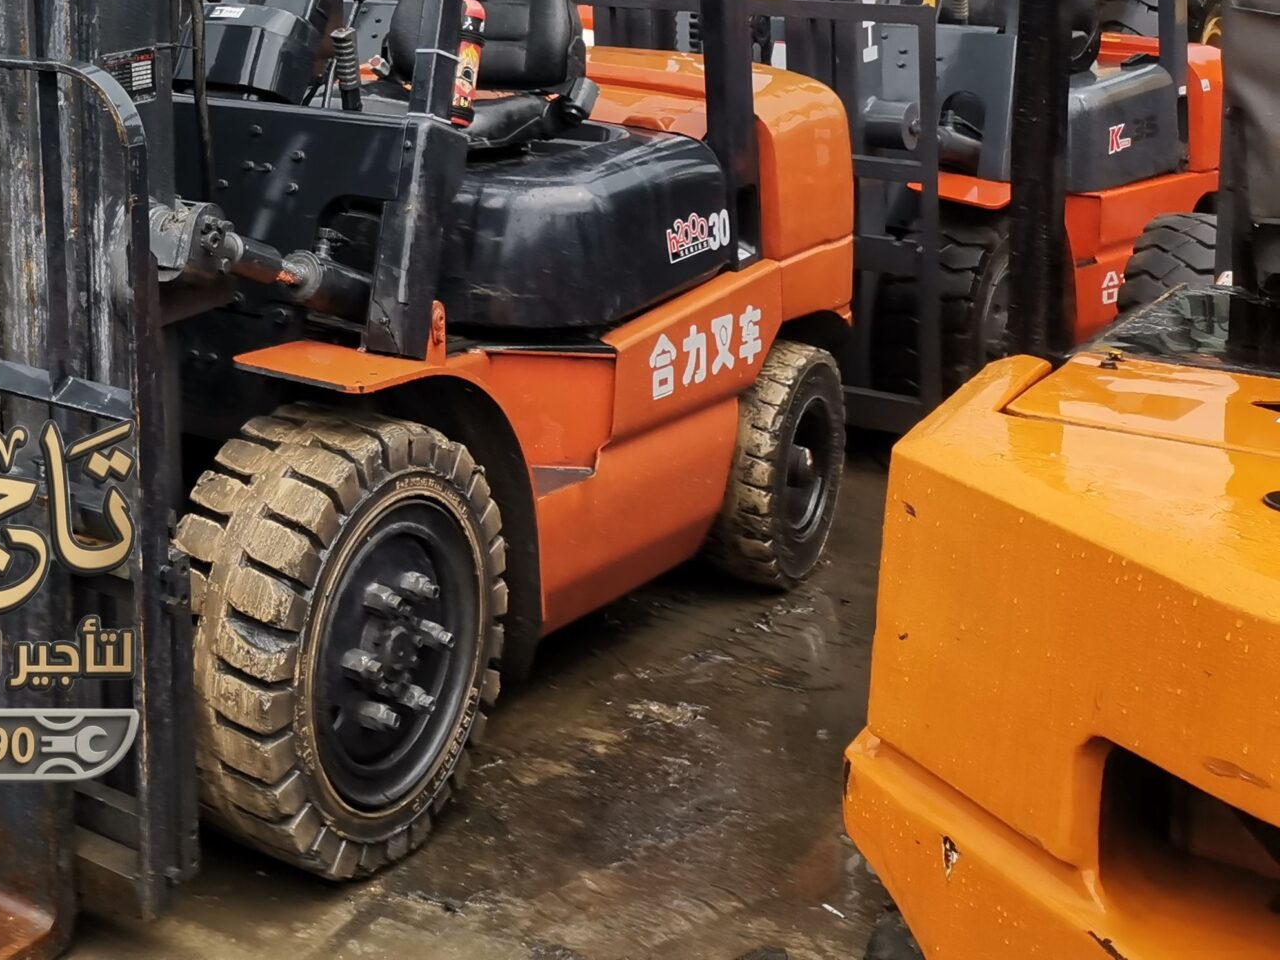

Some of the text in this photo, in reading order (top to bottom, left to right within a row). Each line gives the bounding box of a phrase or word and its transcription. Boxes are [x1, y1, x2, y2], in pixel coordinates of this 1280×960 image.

[708, 208, 731, 251] 30
[649, 305, 762, 400] 合力叉车
